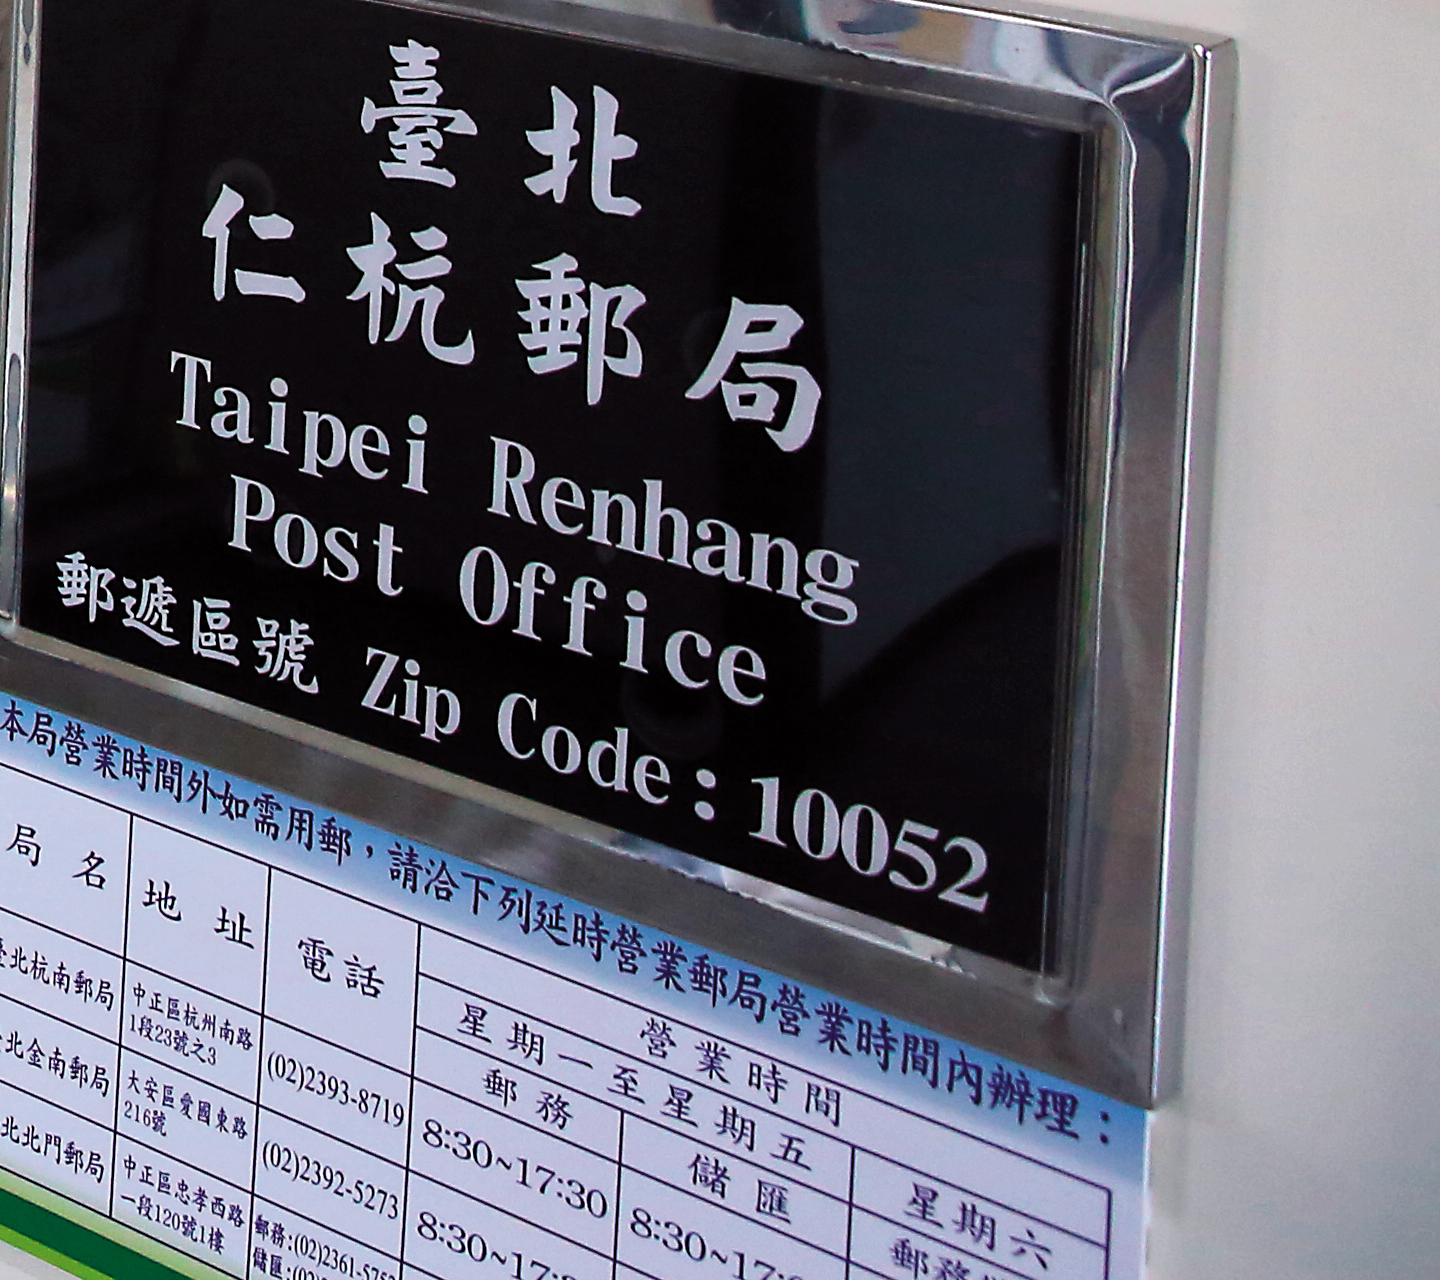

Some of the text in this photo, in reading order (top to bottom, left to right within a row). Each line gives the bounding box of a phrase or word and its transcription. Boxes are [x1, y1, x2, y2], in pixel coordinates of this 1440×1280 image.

[361, 39, 641, 216] 臺北
[203, 184, 821, 451] 仁杭郵局
[171, 351, 859, 624] Taipei Renhang
[57, 552, 318, 693] 郵遞區號
[228, 475, 765, 704] Post Office
[362, 647, 460, 742] Zip
[750, 778, 987, 911] 10052
[6, 824, 106, 890] 局名
[142, 879, 254, 949] 地址
[298, 937, 384, 998] 電話
[130, 1014, 216, 1066] 1段23號之3
[133, 982, 253, 1051] 中正區杭州南路
[127, 1069, 248, 1139] 大安區愛國東路
[268, 1051, 404, 1127] (02)2393-8719
[457, 1003, 812, 1171] 星期一至星期五
[482, 1069, 573, 1130] 郵務
[640, 1017, 840, 1127] 營業時間
[124, 1100, 166, 1137] 216號
[124, 1154, 245, 1228] 中正區忠孝西路
[263, 1140, 398, 1219] (02)2392-5273
[423, 1119, 607, 1218] 8:30~17:30
[688, 1153, 791, 1224] 儲匯
[121, 1194, 224, 1255] 一段120號1樓
[254, 1214, 396, 1280] 郵務:(02)2361-57
[417, 1212, 576, 1280] 8:30~17:
[630, 1208, 805, 1280] 8:30~17:
[890, 1238, 998, 1280] 郵務
[904, 1182, 1051, 1270] 星期六
